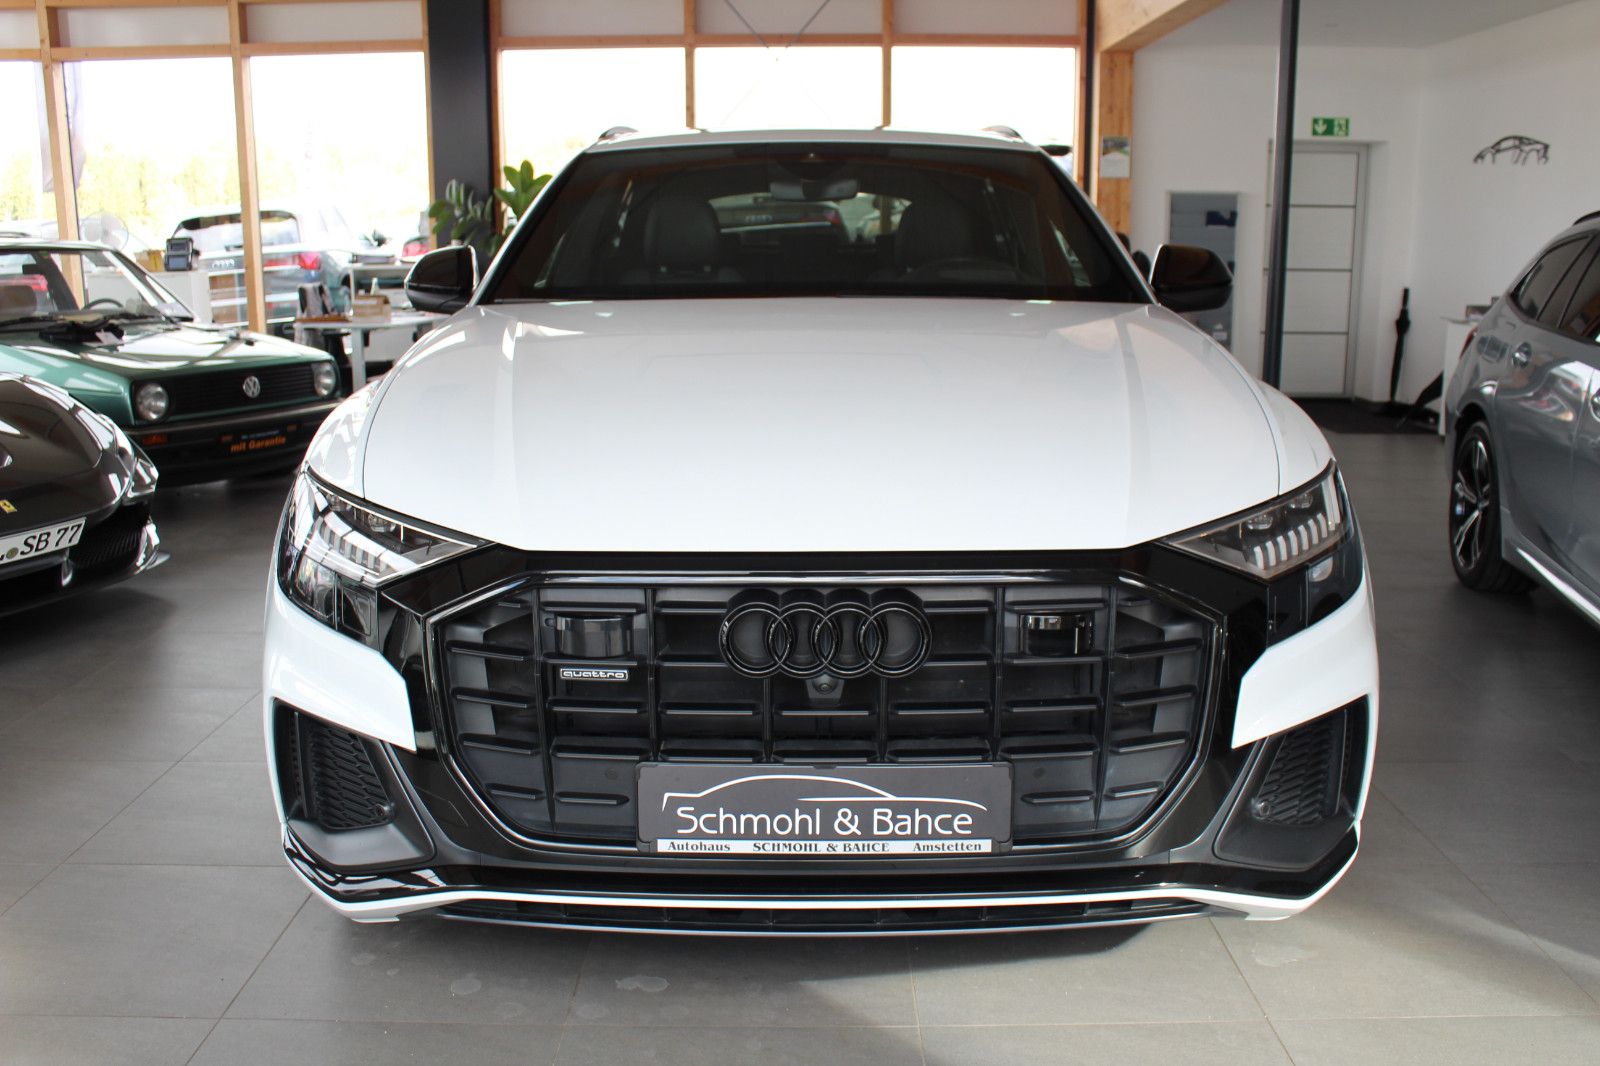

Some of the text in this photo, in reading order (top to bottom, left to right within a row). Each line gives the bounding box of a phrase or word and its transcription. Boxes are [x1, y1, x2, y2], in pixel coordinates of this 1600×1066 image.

[231, 436, 286, 453] mit Garantie
[20, 523, 83, 556] SB 77
[563, 671, 625, 679] quattro
[676, 806, 973, 836] Schmohl & Bahce
[667, 841, 982, 853] Autohaus SCHMOHL & BAHCE Amstetten
